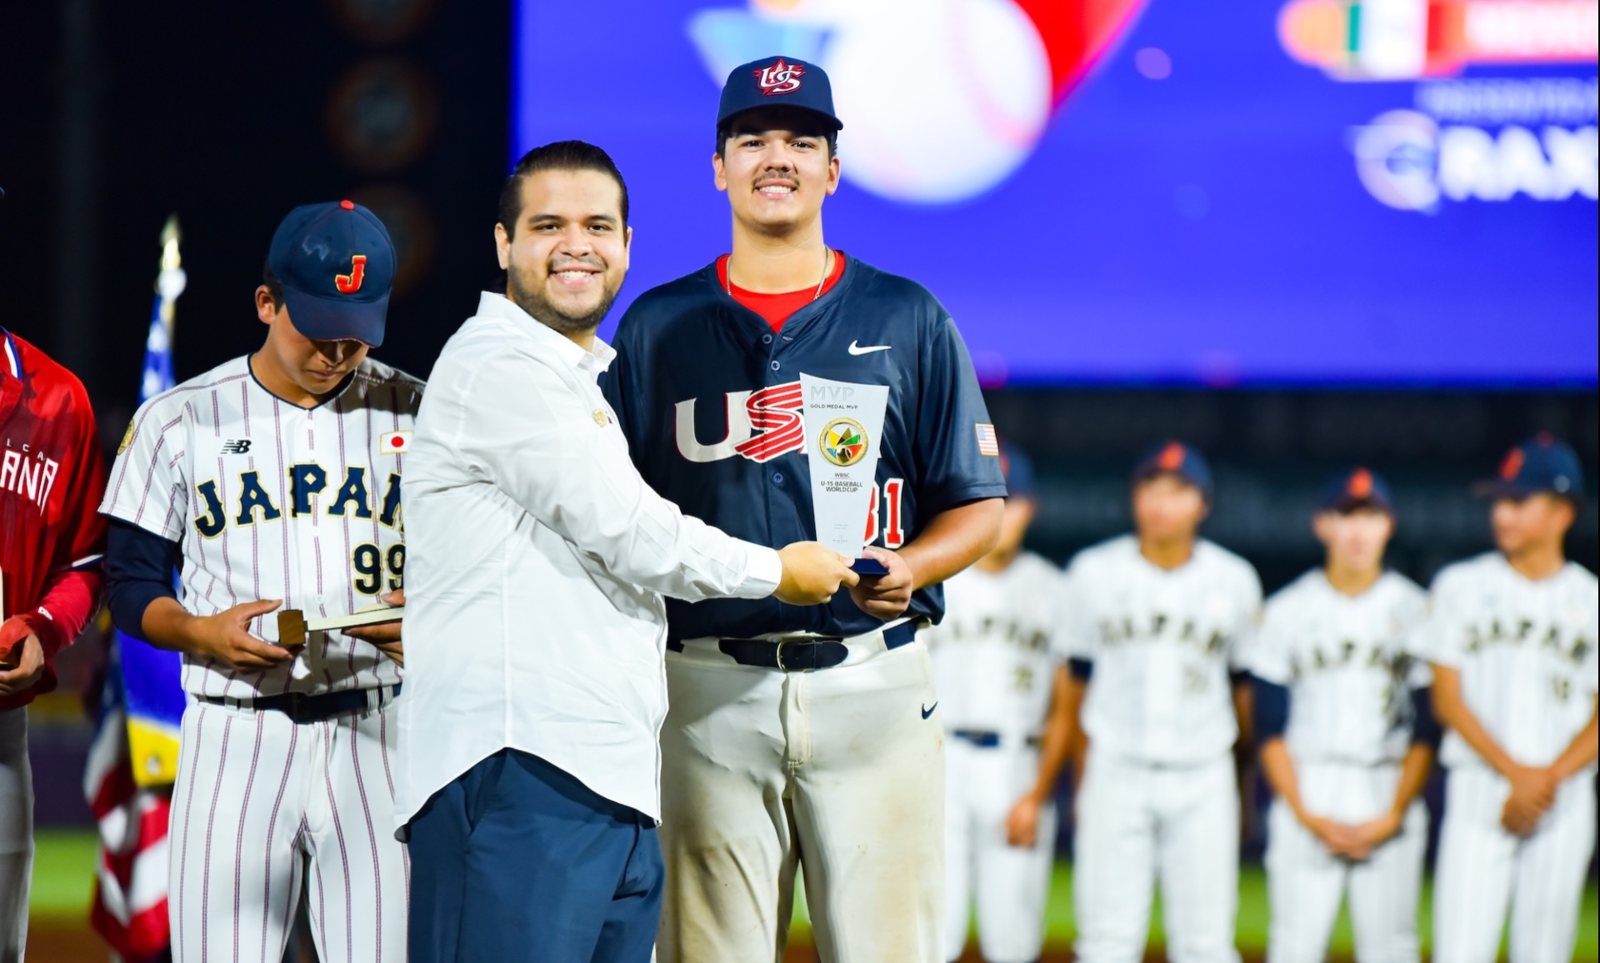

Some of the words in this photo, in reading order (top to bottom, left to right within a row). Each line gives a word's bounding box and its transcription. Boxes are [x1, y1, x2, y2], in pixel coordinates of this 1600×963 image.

[335, 255, 368, 295] J
[810, 385, 855, 401] MVP
[674, 380, 808, 464] US
[353, 543, 406, 596] 99
